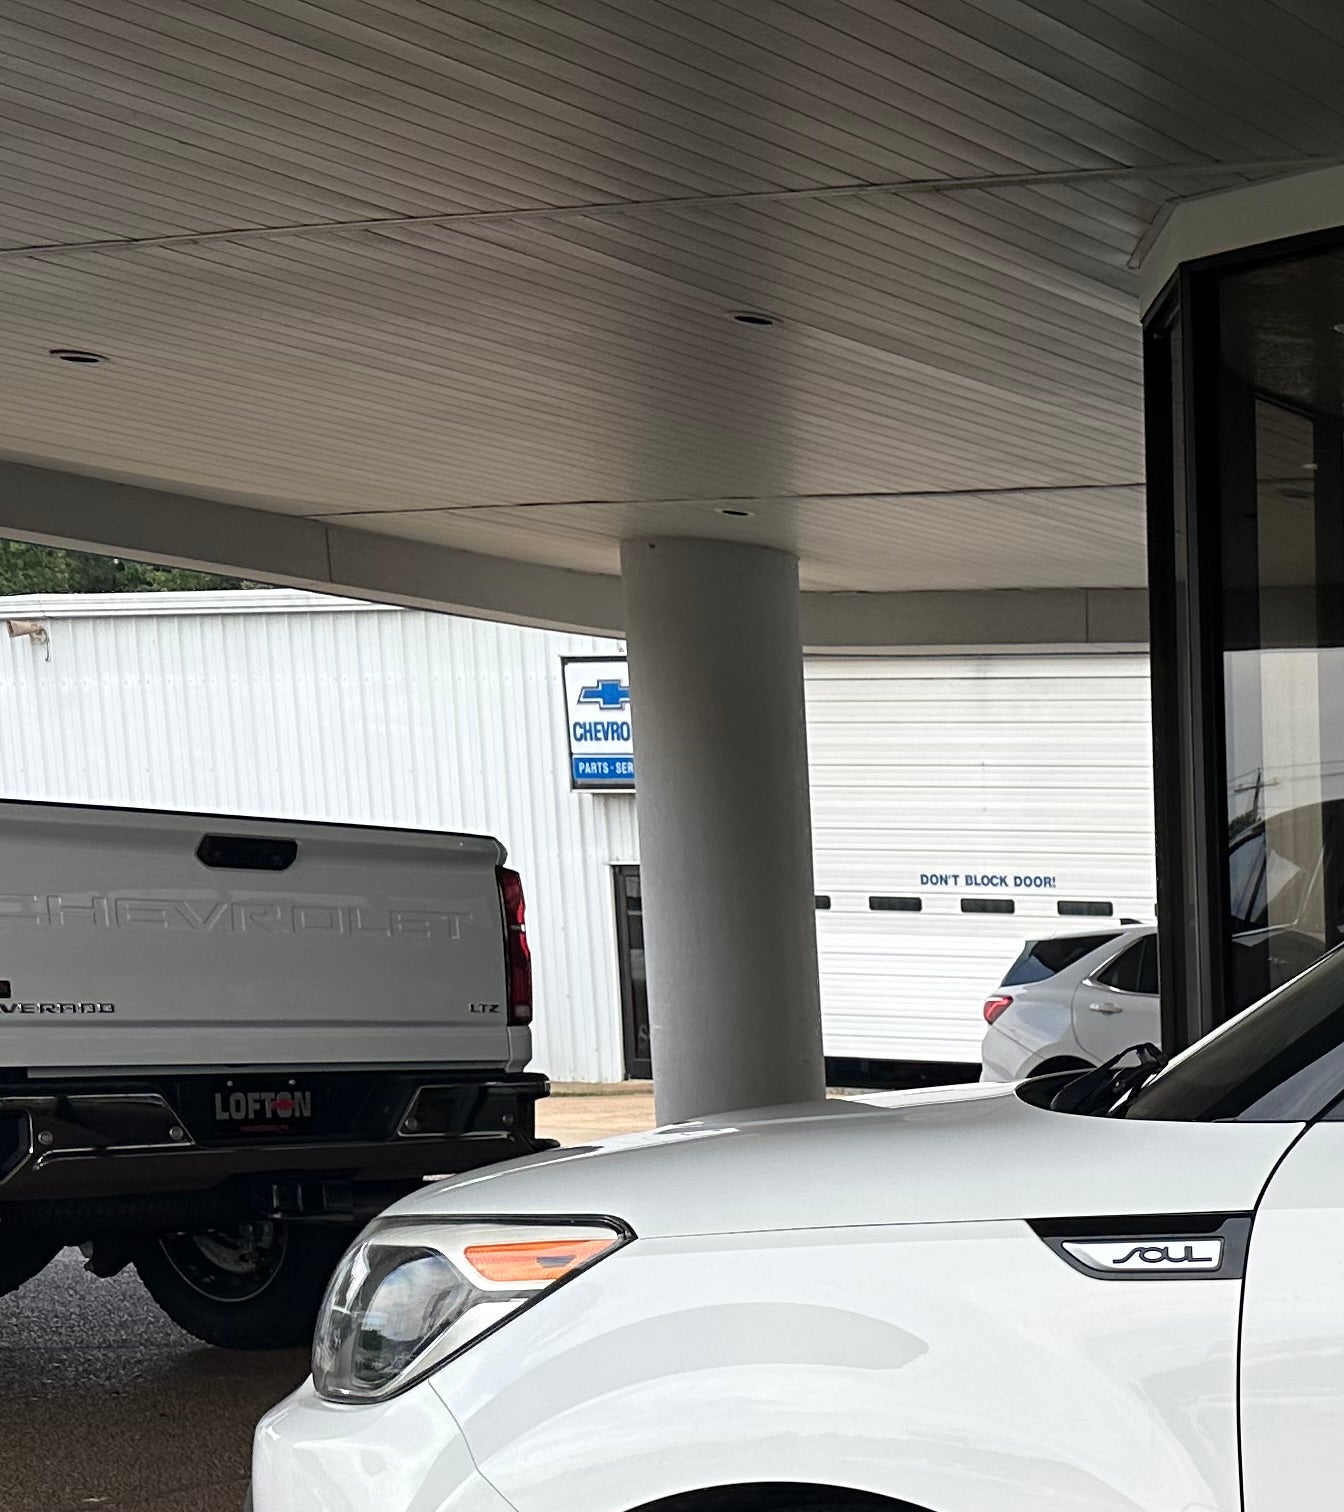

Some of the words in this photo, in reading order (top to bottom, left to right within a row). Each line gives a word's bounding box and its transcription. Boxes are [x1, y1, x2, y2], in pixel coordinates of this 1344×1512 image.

[573, 721, 631, 742] CHEVRO
[920, 873, 959, 886] DON'T
[965, 874, 1008, 888] BLOCK
[1014, 875, 1056, 889] DOOR!
[469, 1003, 500, 1014] LTZ
[214, 1091, 312, 1121] LOFTON
